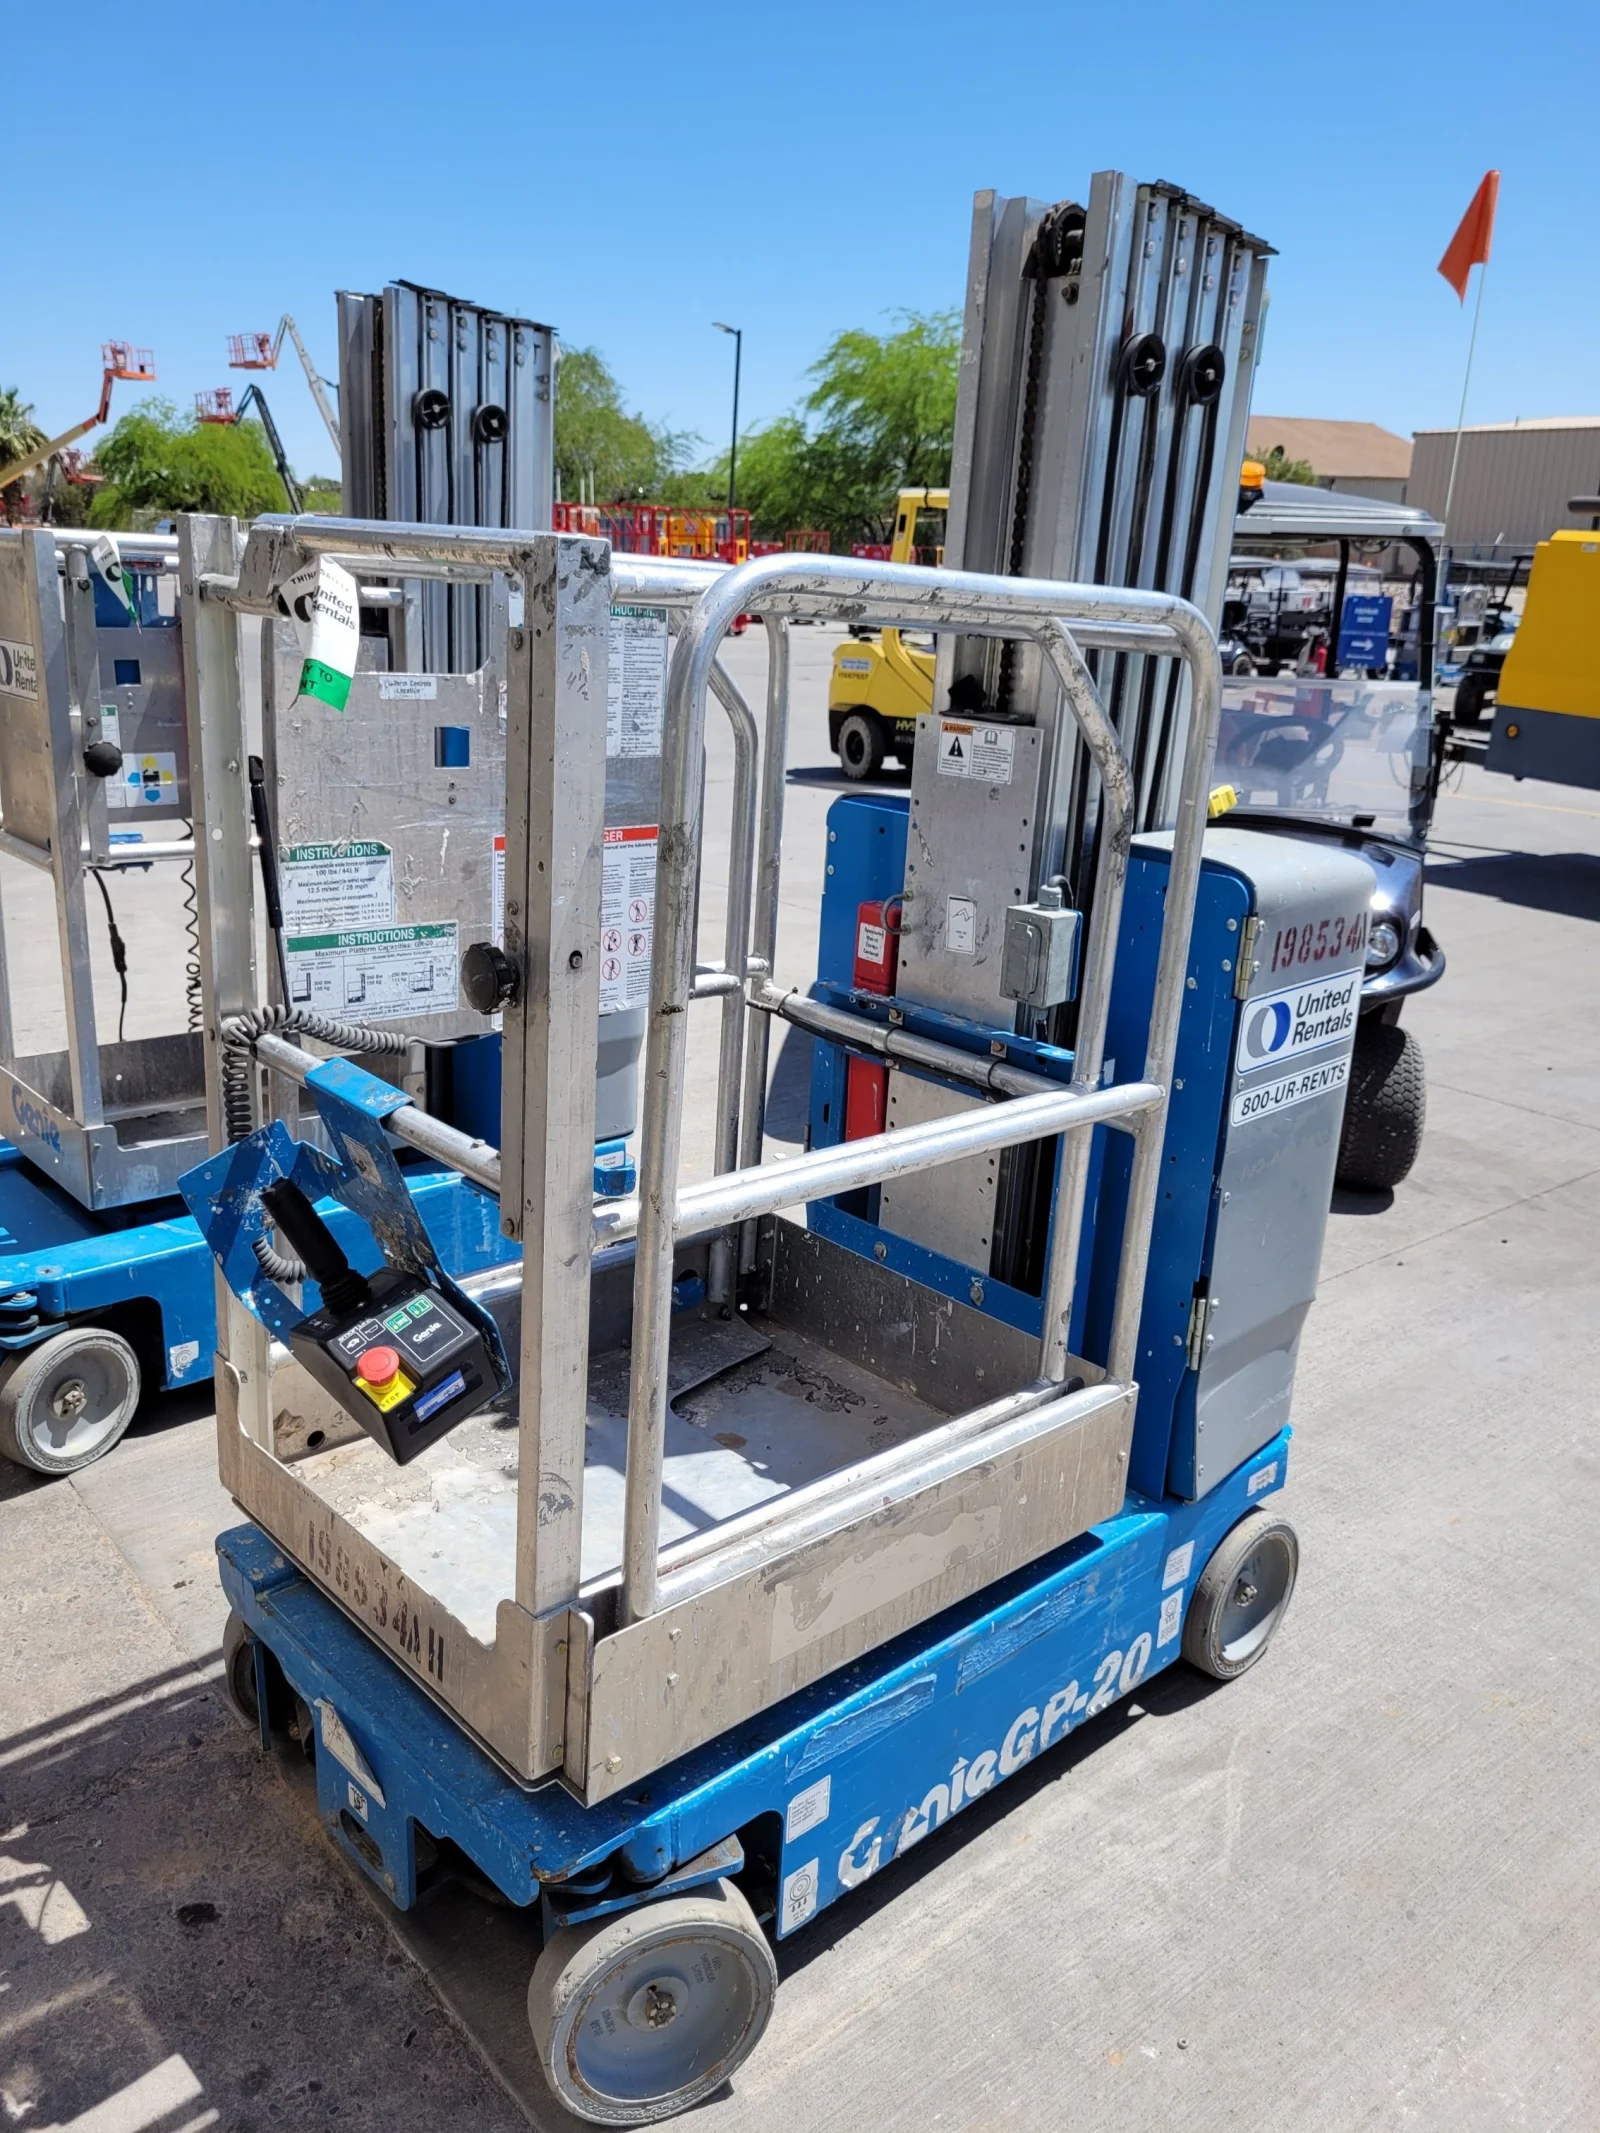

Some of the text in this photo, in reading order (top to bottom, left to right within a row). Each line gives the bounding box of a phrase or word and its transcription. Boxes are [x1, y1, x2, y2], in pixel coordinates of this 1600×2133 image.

[319, 668, 333, 683] TO
[338, 928, 416, 947] INSTRUCTIONS
[315, 949, 347, 957] Maximum
[349, 946, 377, 954] Platform
[1295, 980, 1355, 1019] United
[1292, 1010, 1353, 1046] Rentals
[1241, 1062, 1347, 1117] 800-UR-RENTS
[412, 1321, 442, 1340] Genie
